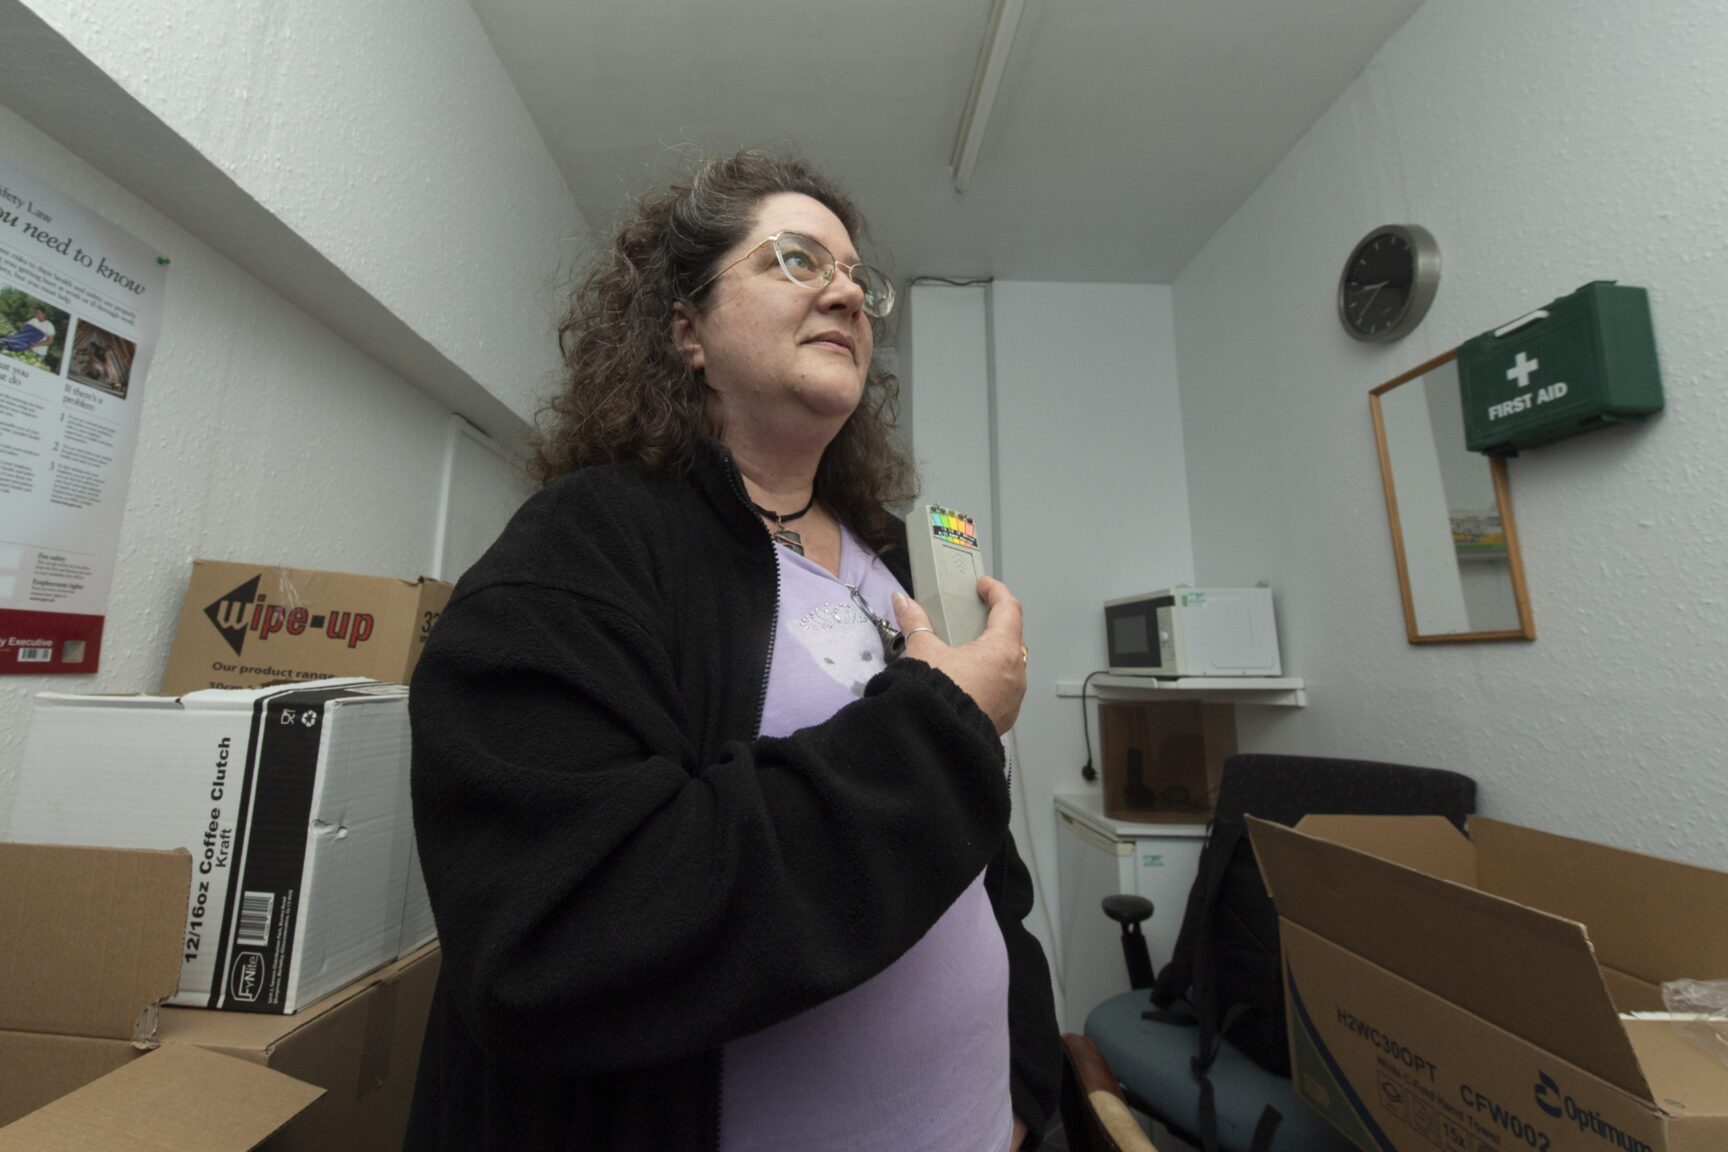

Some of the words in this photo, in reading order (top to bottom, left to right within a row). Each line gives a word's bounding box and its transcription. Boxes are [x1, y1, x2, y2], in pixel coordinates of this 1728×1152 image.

[0, 187, 24, 208] fety
[27, 201, 53, 223] Law
[22, 222, 72, 256] need
[73, 248, 93, 268] to
[97, 257, 146, 296] know
[1488, 393, 1533, 421] FIRST
[1536, 382, 1568, 404] AID
[8, 637, 53, 647] Executive
[212, 662, 237, 674] Our
[239, 664, 293, 678] product
[185, 879, 210, 963] 12/16oz
[200, 807, 221, 875] Coffee
[211, 737, 231, 801] Clutch
[216, 828, 232, 868] Kraft
[1460, 1084, 1552, 1152] CFW002
[1564, 1095, 1652, 1152] Optimum
